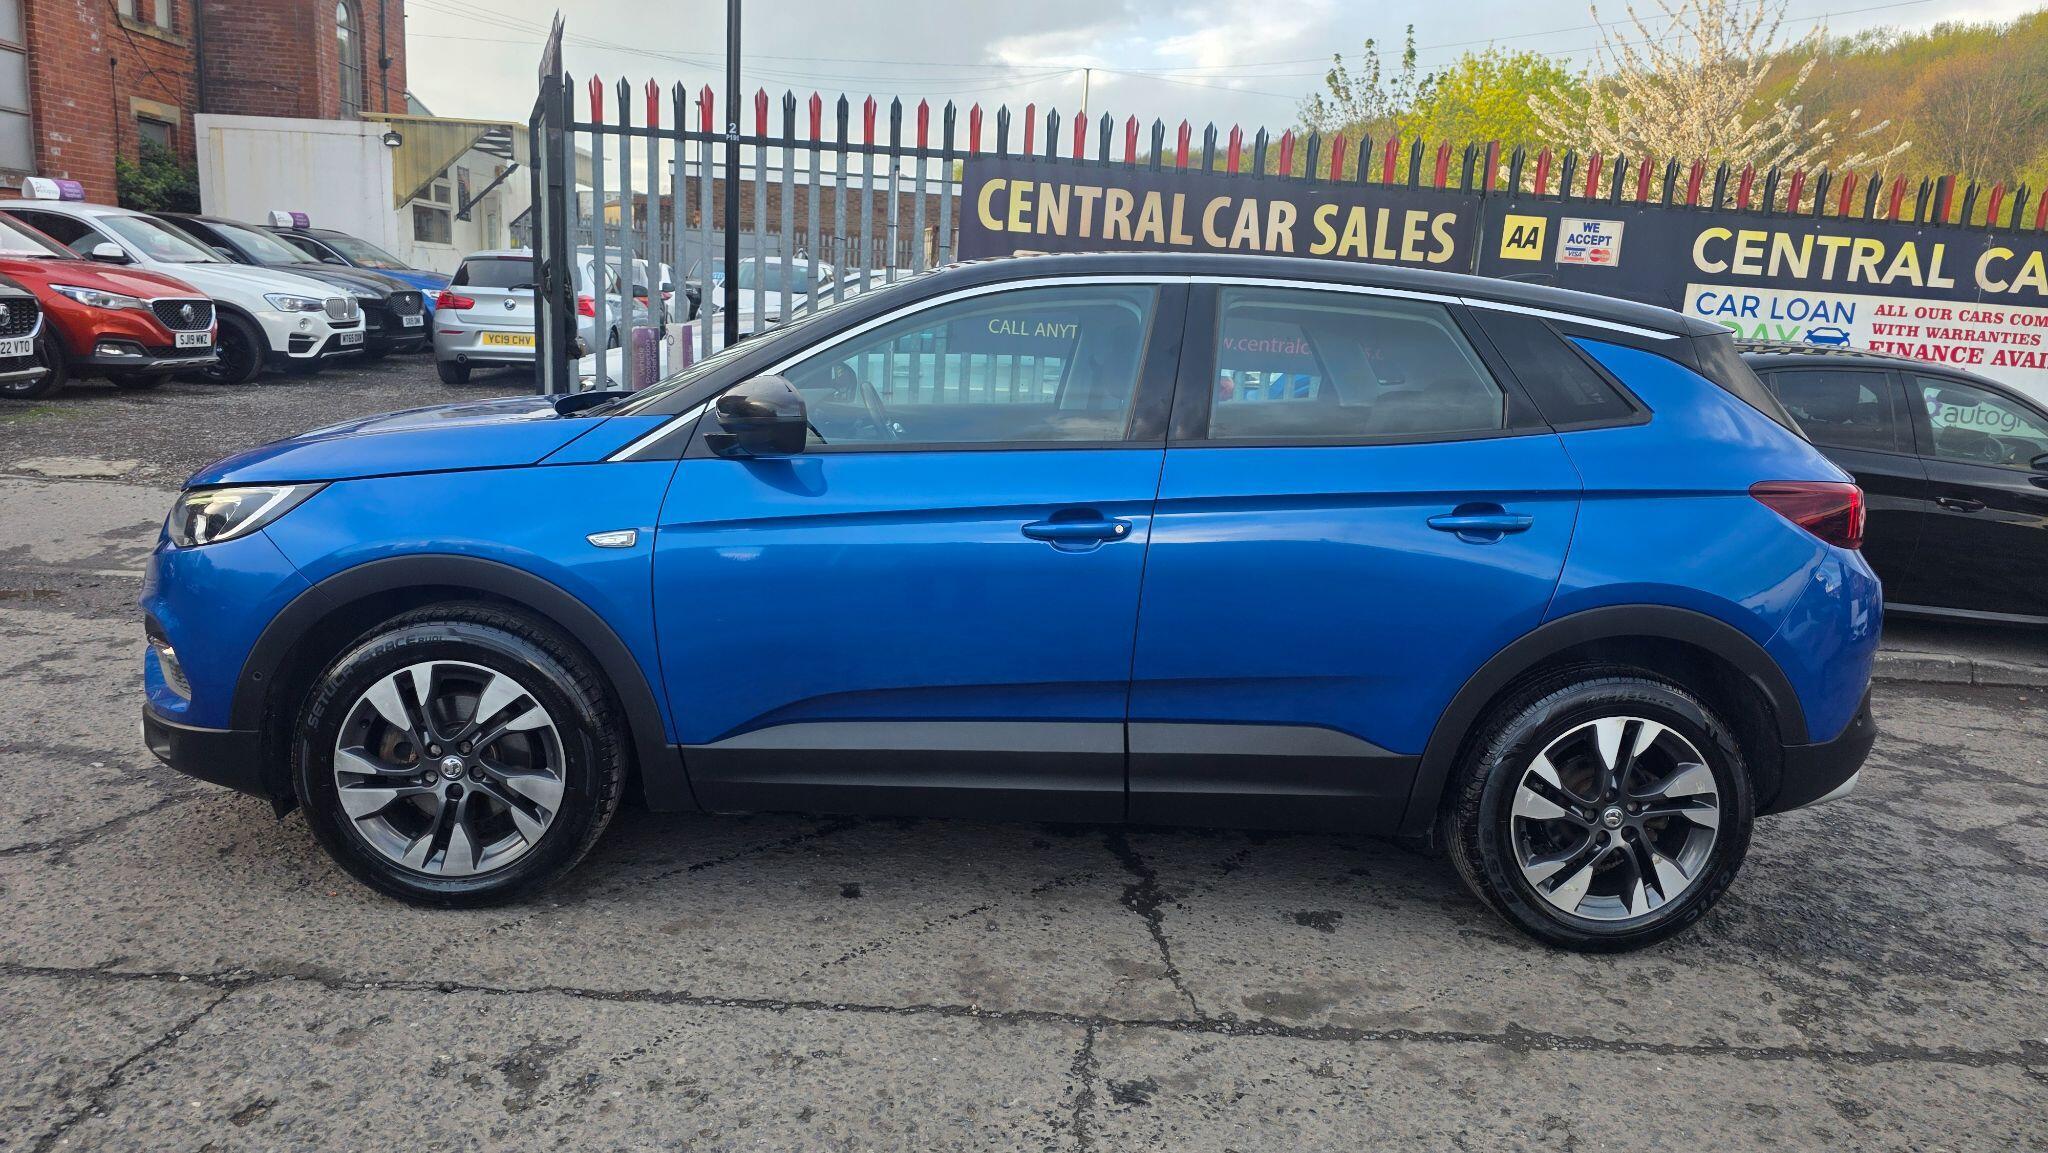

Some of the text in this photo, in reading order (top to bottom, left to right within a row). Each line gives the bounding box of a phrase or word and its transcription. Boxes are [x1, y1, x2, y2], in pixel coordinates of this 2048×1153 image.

[729, 122, 737, 134] 2
[977, 178, 1457, 264] CENTRAL CAR SALES
[1583, 222, 1600, 233] WE
[1506, 225, 1540, 250] AA
[1566, 233, 1613, 247] ACCEPT
[1692, 227, 2048, 296] CENTRAL CA
[1696, 291, 1857, 325] CAR LOAN
[1873, 304, 1908, 318] ALL
[1914, 306, 1953, 321] OUR
[1958, 309, 2004, 325] CARS
[488, 334, 510, 344] YC19
[988, 319, 1078, 339] CALL ANYT
[1871, 322, 2042, 346] WITH WARRANTIES
[1868, 340, 1985, 364] FINANCE
